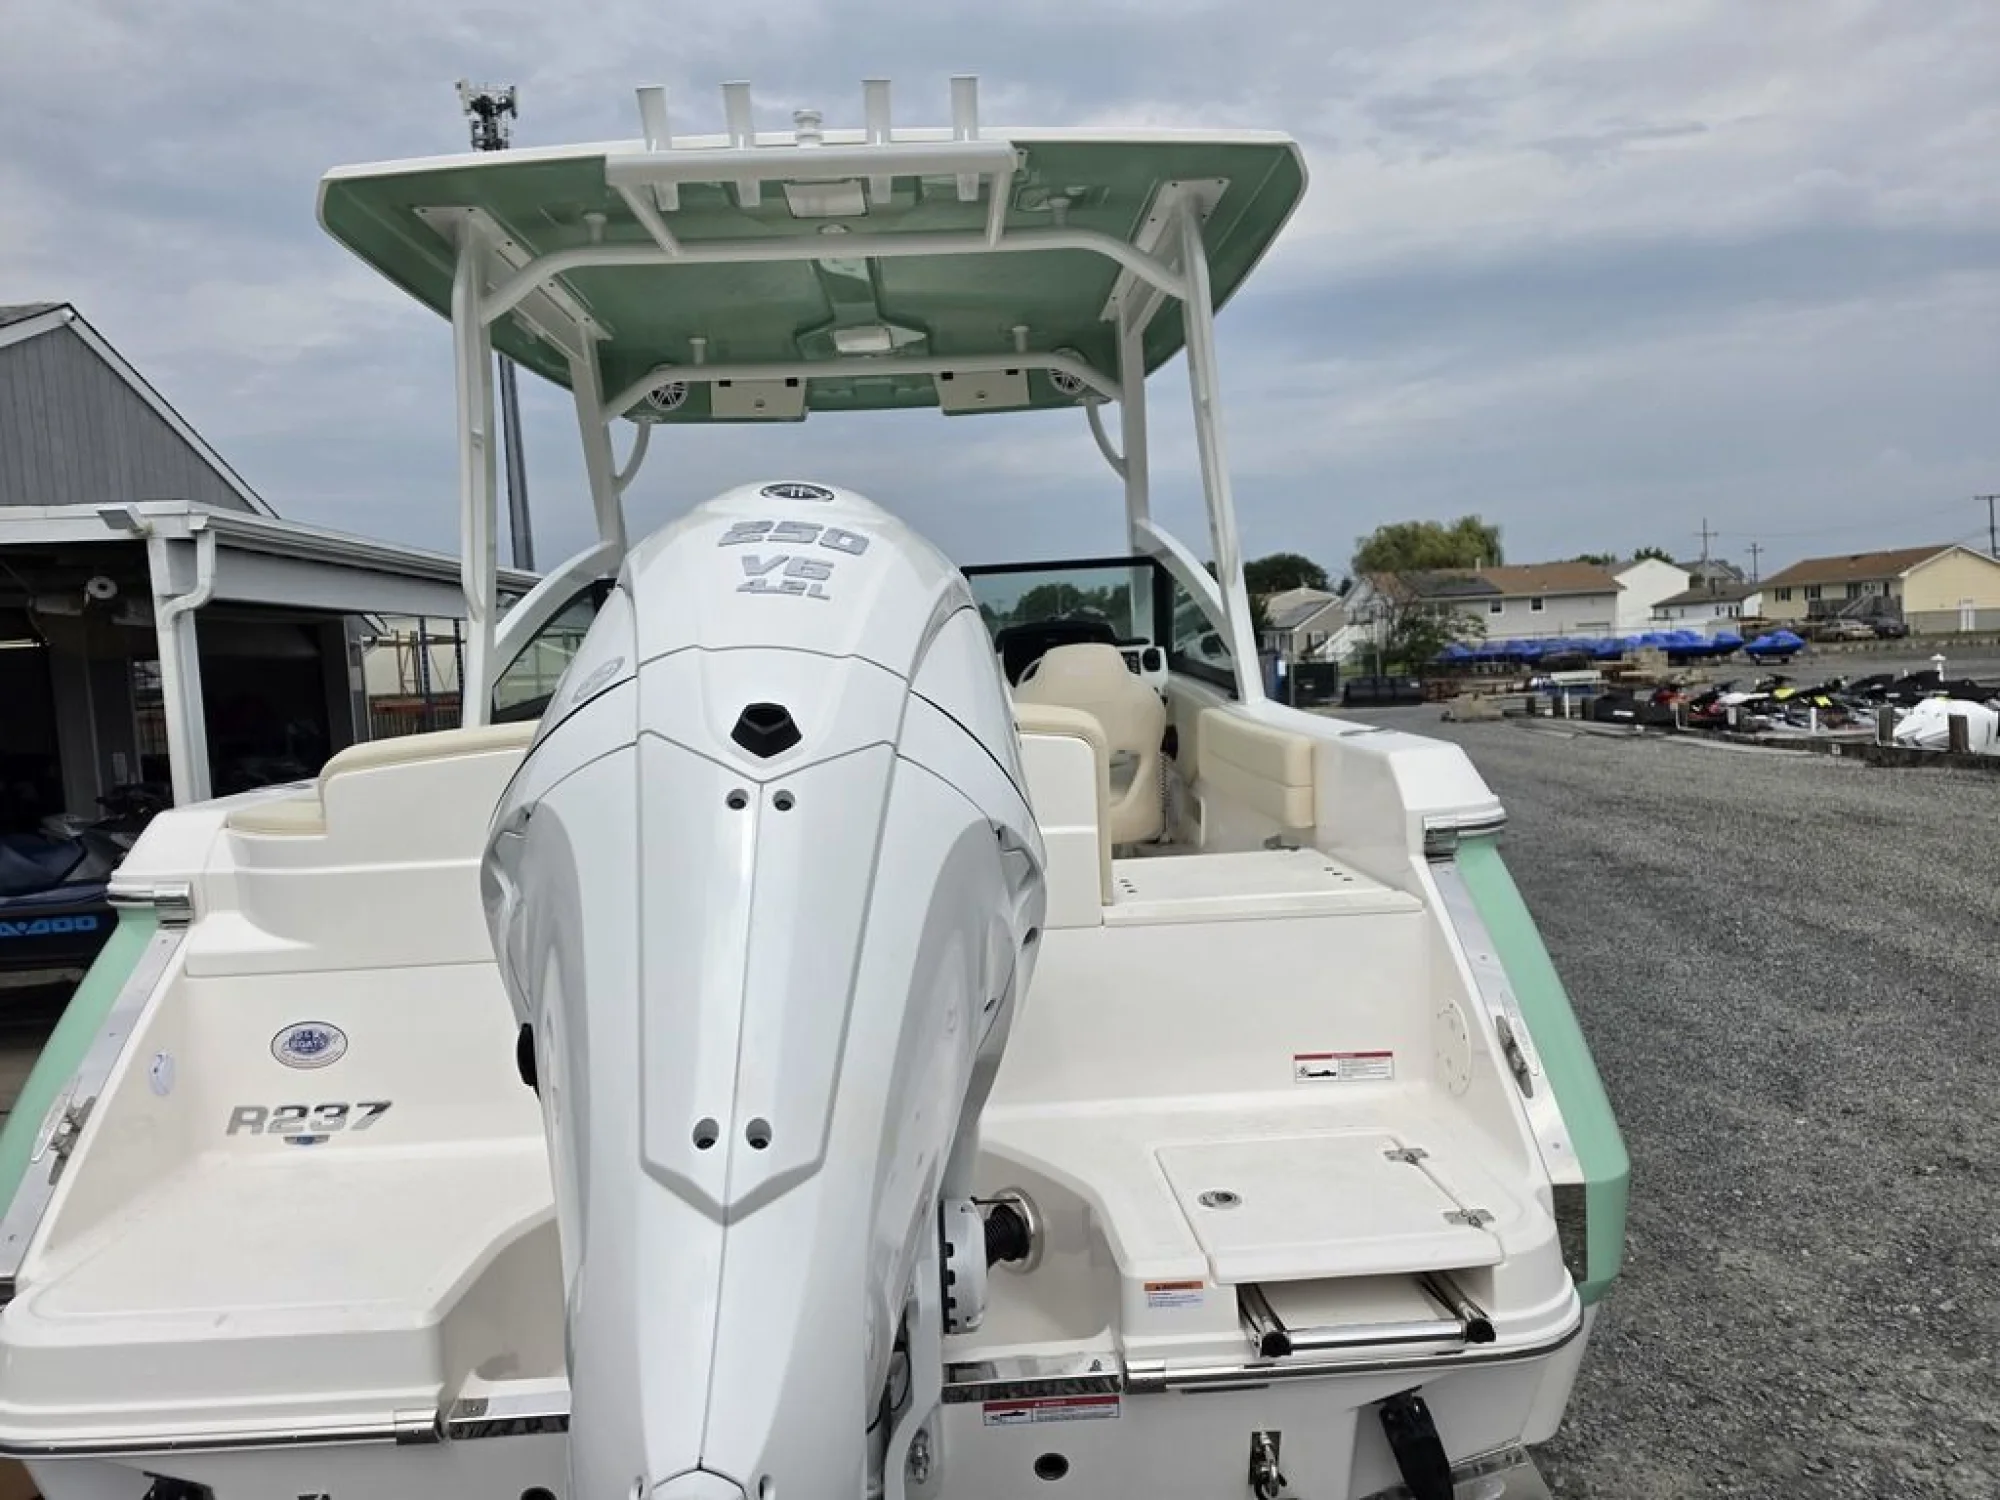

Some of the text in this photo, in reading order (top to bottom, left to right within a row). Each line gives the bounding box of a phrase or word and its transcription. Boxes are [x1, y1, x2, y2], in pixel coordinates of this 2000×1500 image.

[717, 520, 869, 556] 250
[741, 554, 835, 580] V6
[226, 1101, 393, 1137] R237
